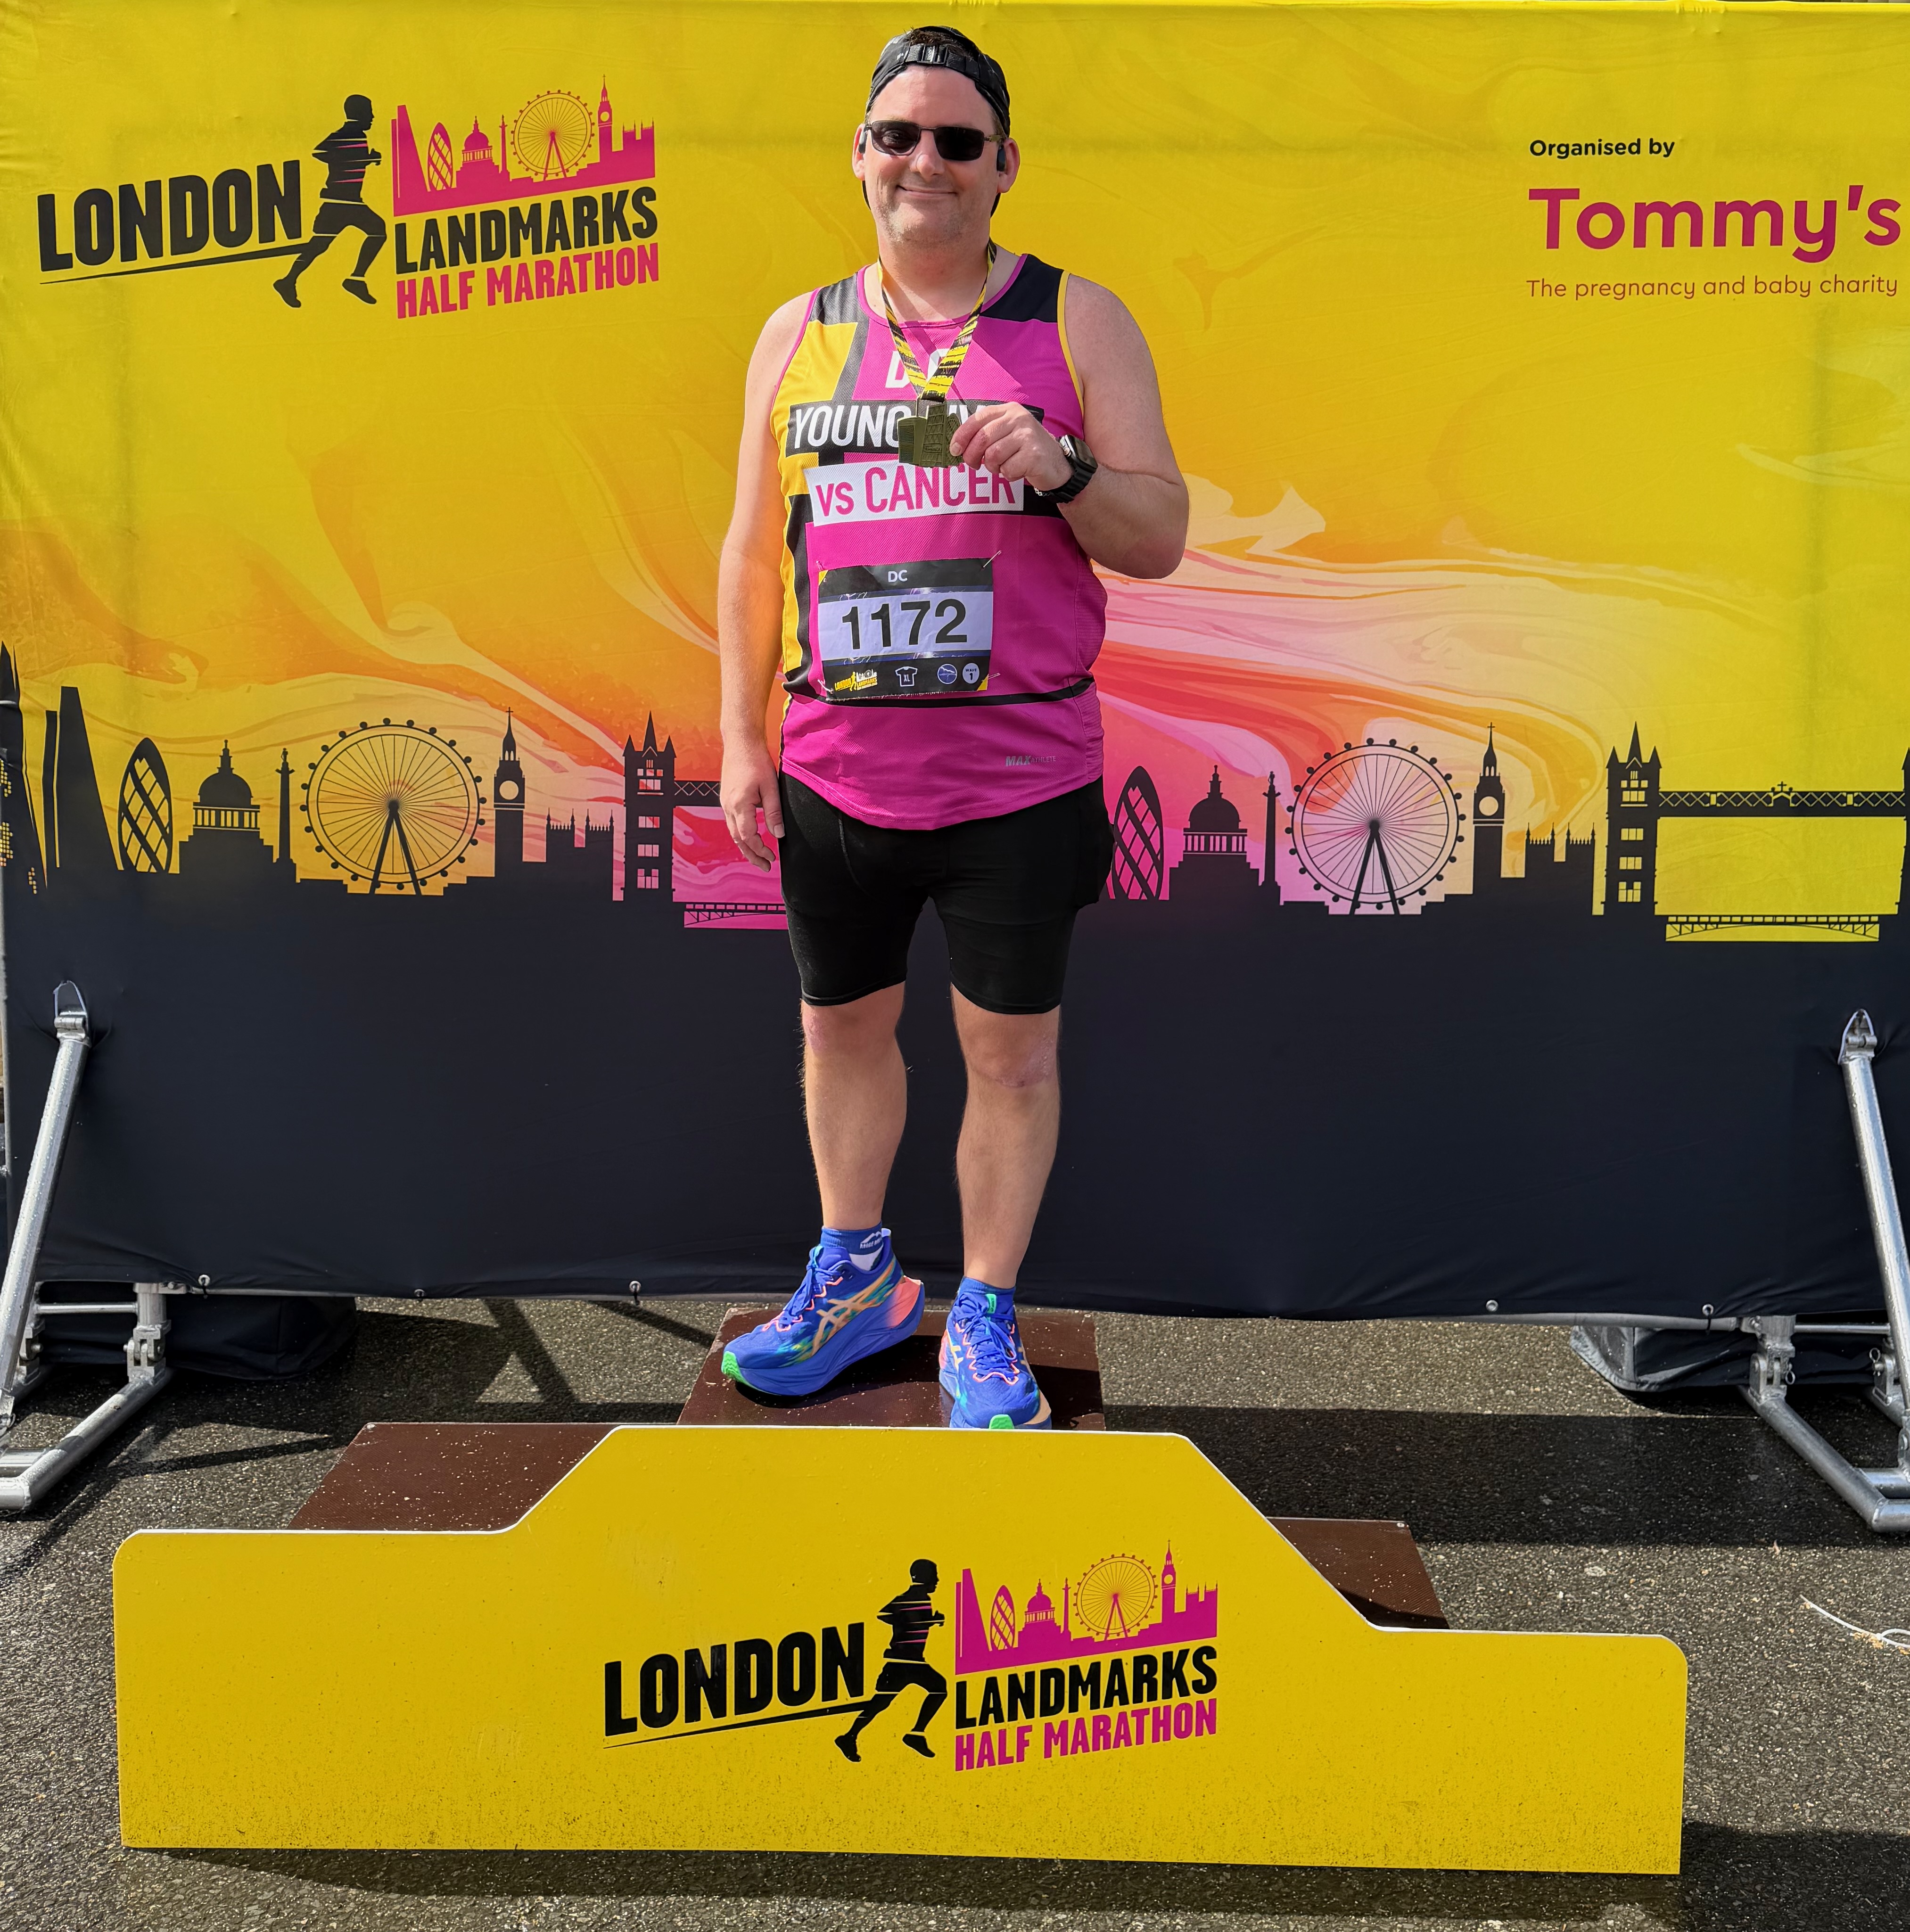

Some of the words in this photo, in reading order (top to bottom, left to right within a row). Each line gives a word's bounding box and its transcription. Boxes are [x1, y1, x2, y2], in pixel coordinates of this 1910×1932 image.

[1530, 138, 1641, 159] Organised
[1649, 138, 1675, 157] by
[38, 160, 302, 272] LONDON
[395, 186, 658, 274] LANDMARKS
[1529, 185, 1902, 263] Tommy's
[397, 270, 475, 319] HALF
[487, 242, 659, 306] MARATHON
[1526, 279, 1567, 297] The
[1576, 282, 1696, 300] pregnancy
[1703, 276, 1745, 295] and
[1754, 275, 1811, 298] baby
[1819, 274, 1898, 297] charity
[865, 463, 1016, 513] CANCER
[888, 569, 907, 583] DC
[842, 599, 967, 650] 1172
[903, 674, 910, 682] XL
[970, 673, 973, 681] 1
[605, 1622, 864, 1736] LONDON
[955, 1645, 1217, 1730] LANDMARKS
[955, 1725, 1032, 1771] HALF
[1044, 1698, 1217, 1759] MARATHON
